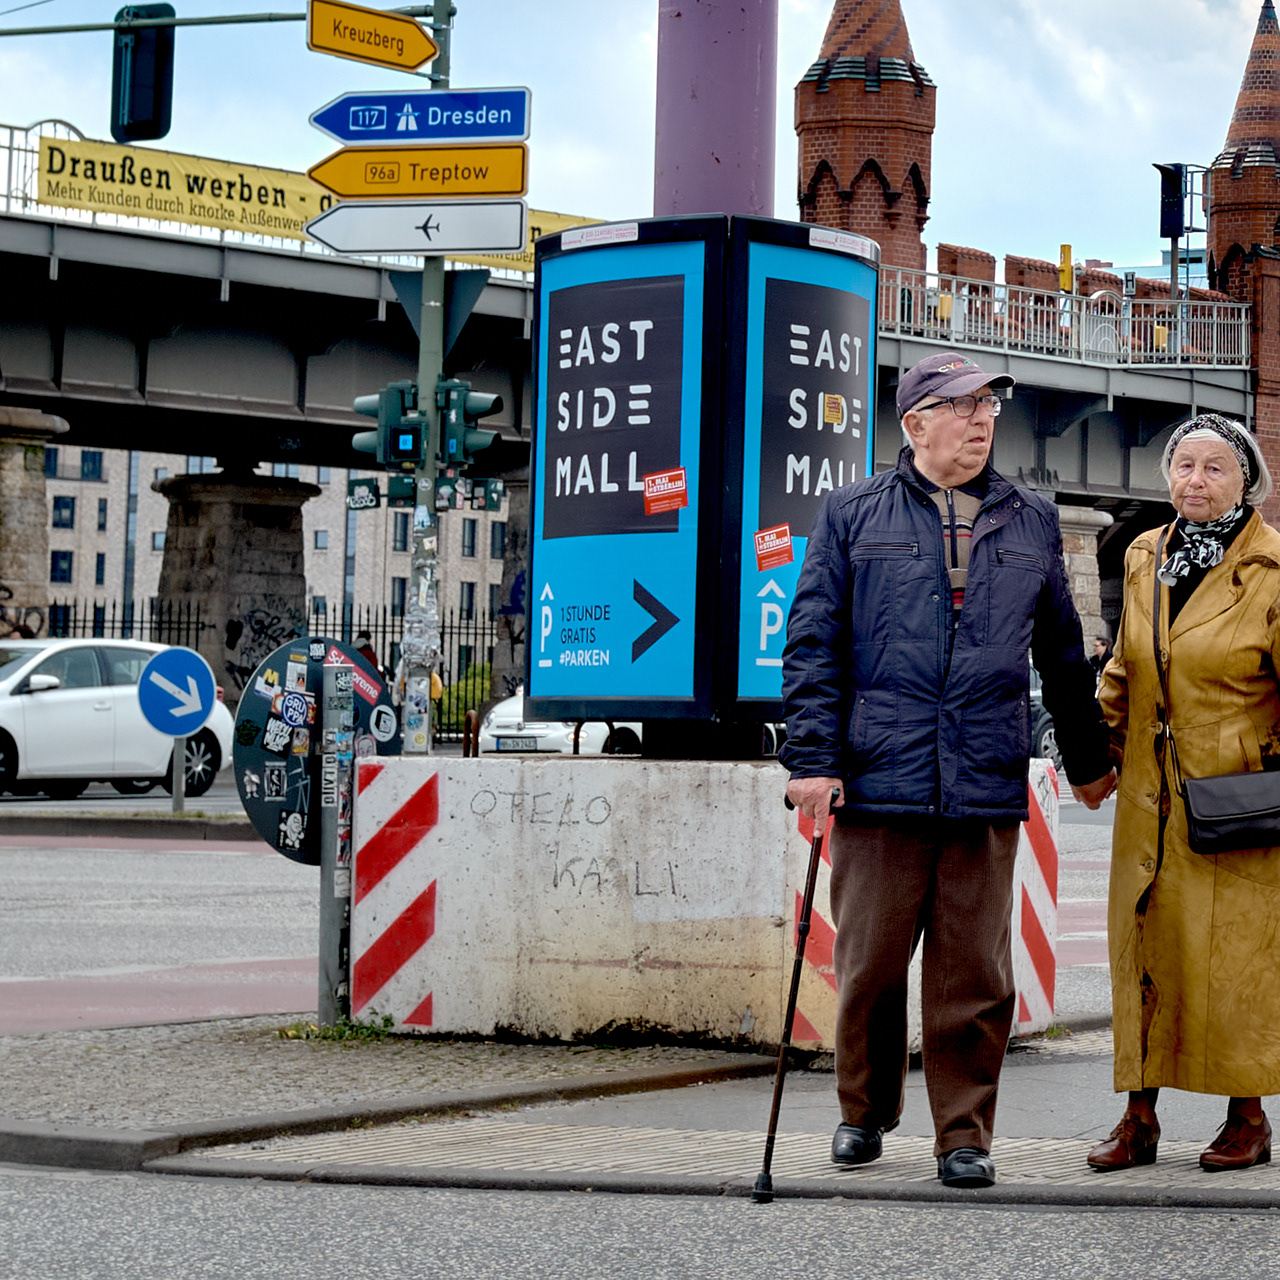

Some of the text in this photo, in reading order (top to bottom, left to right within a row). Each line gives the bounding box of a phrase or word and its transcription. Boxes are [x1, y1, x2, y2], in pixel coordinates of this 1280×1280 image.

[333, 18, 404, 56] Kreuzberg
[357, 106, 511, 126] 117 Dresden
[47, 146, 171, 190] Draußen
[186, 174, 287, 208] werben
[369, 163, 489, 185] 96a Treptow
[46, 180, 83, 201] Mehr
[88, 185, 141, 209] Kunden
[146, 190, 184, 215] durch
[190, 197, 235, 222] knorke
[559, 320, 654, 369] EAST
[789, 323, 862, 376] EAST
[557, 384, 652, 432] SIDE
[788, 388, 861, 438] SIDE
[555, 451, 645, 497] MALL
[559, 649, 610, 666] #PARKEN
[560, 627, 596, 644] GRATIS
